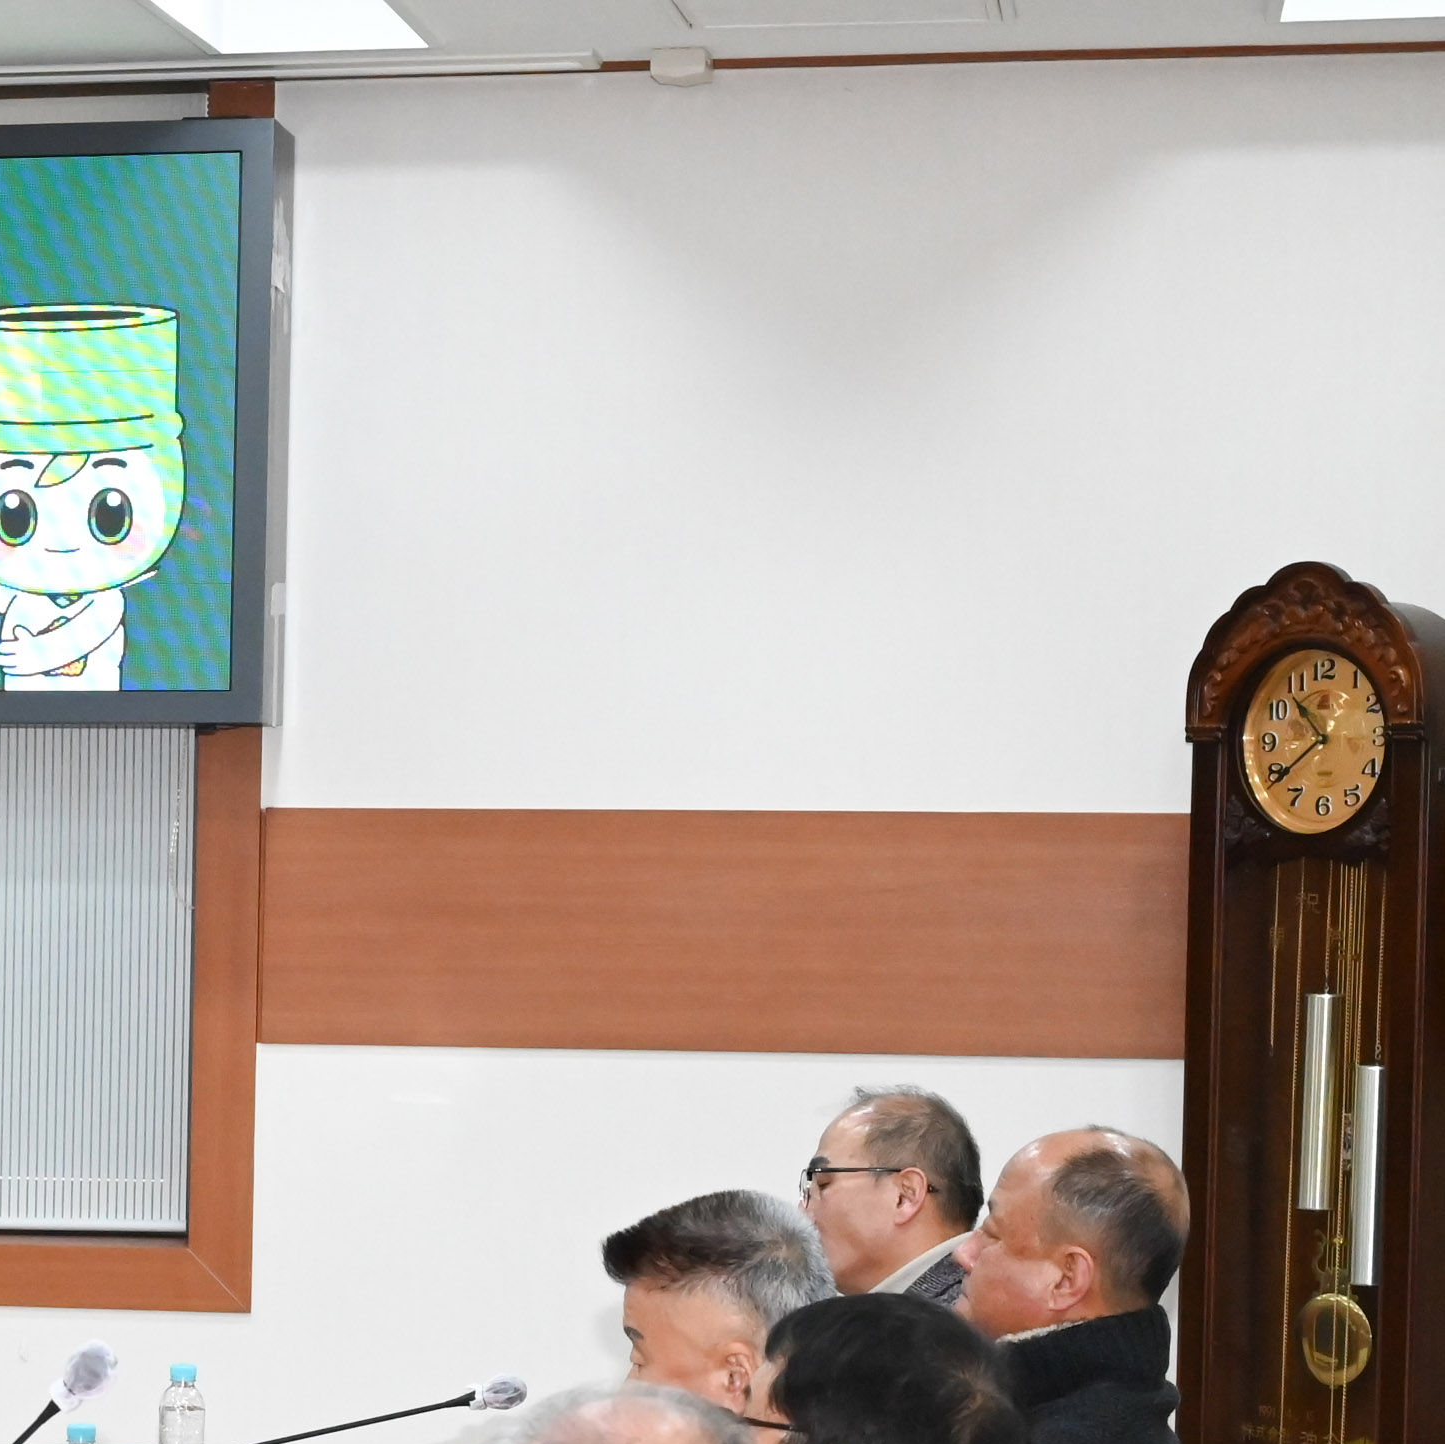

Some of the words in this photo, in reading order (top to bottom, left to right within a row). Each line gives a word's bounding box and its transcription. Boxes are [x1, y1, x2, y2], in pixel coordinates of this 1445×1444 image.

[1313, 658, 1337, 682] 12
[1352, 668, 1361, 689] 1
[1287, 669, 1307, 694] 11
[1269, 699, 1290, 721] 10
[1366, 694, 1382, 714] 2
[1261, 732, 1279, 752] 9
[1372, 726, 1386, 747] 3
[1267, 762, 1286, 784] 8
[1361, 757, 1380, 778] 4
[1287, 785, 1305, 808] 7
[1315, 795, 1333, 817] 6
[1344, 784, 1361, 807] 5
